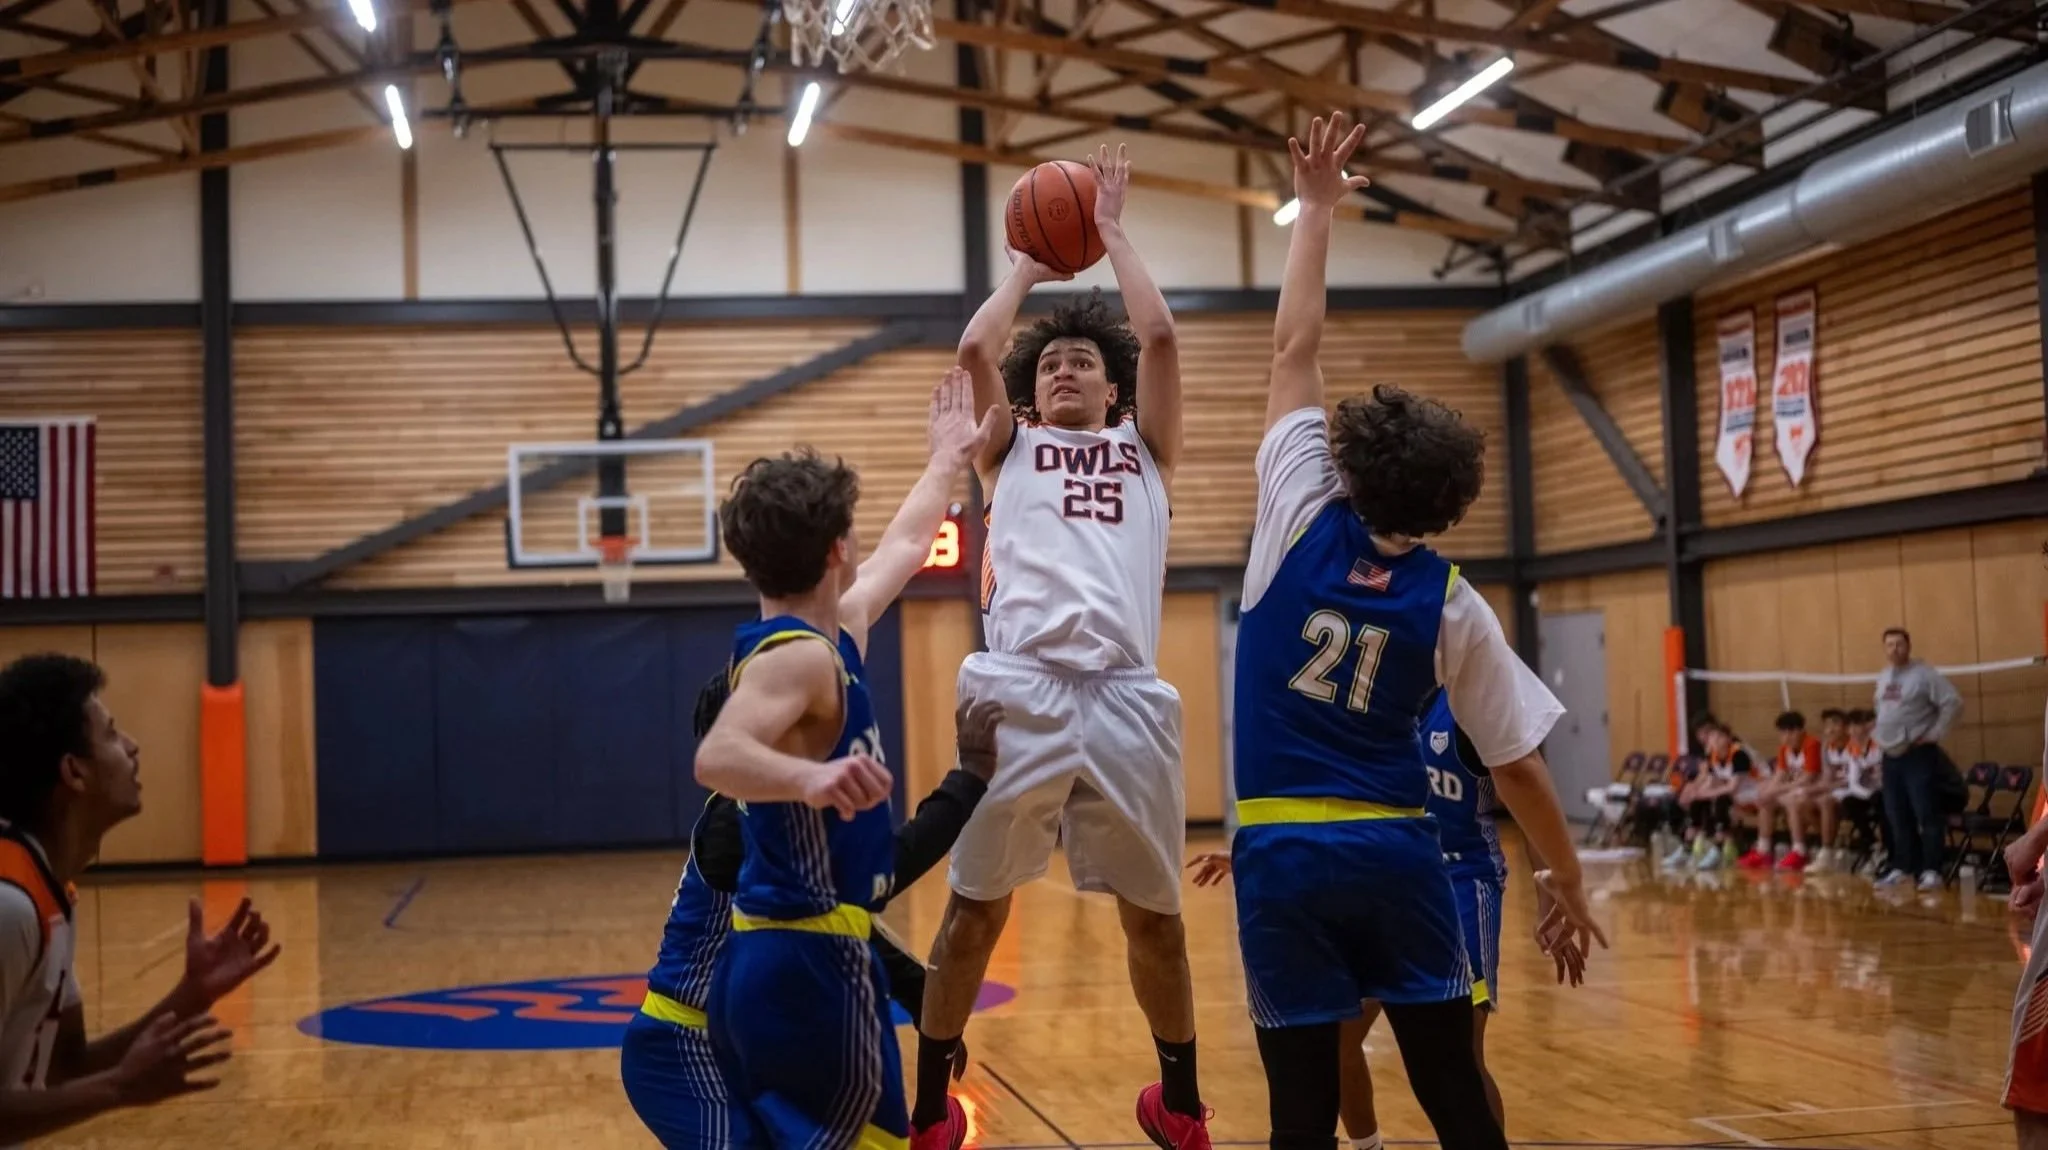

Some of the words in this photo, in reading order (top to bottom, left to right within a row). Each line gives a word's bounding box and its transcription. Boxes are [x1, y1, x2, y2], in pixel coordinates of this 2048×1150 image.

[1034, 439, 1142, 476] OWLS
[1063, 478, 1123, 525] 25
[1288, 609, 1390, 713] 21
